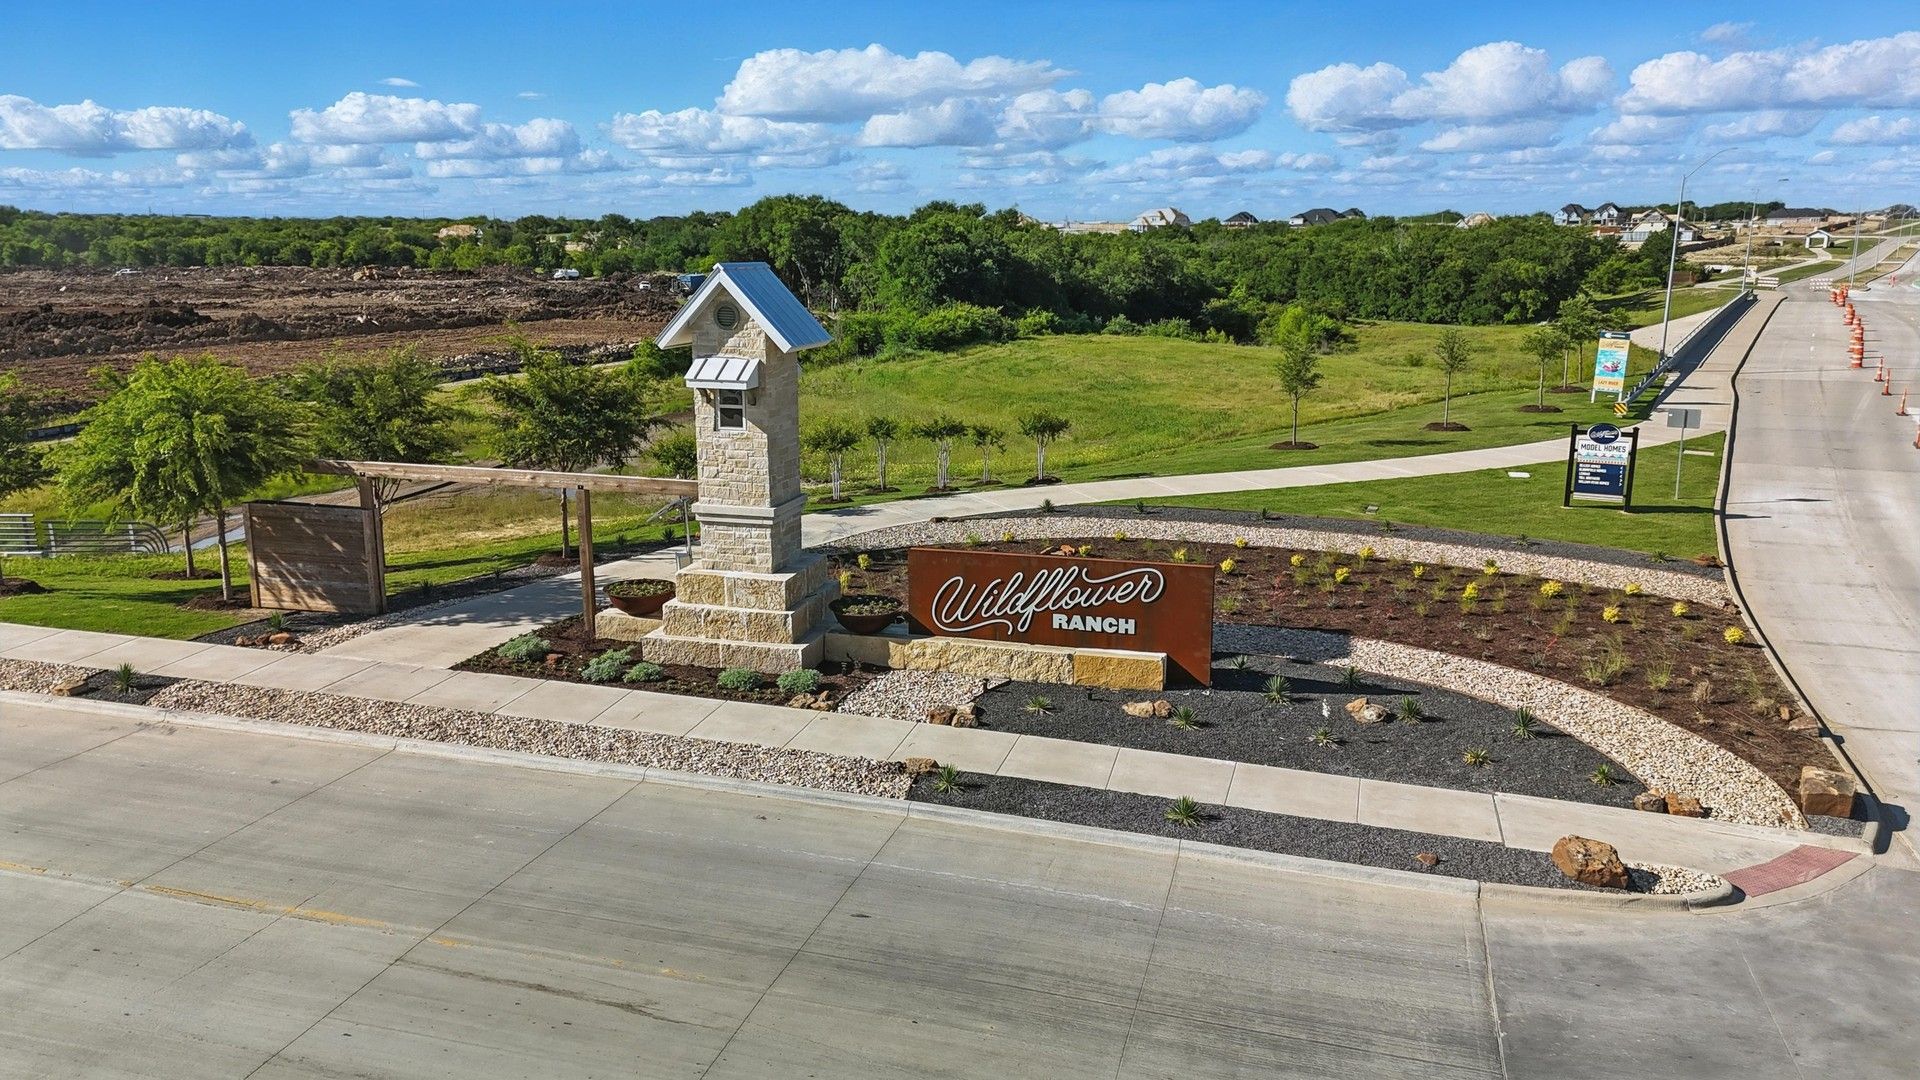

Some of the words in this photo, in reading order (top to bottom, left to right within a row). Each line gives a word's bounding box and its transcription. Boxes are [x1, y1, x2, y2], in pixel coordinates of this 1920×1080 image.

[1581, 443, 1601, 451] MODEL
[1604, 445, 1626, 453] HOMES
[932, 565, 1164, 635] Wildflower
[1052, 613, 1136, 635] RANCH
